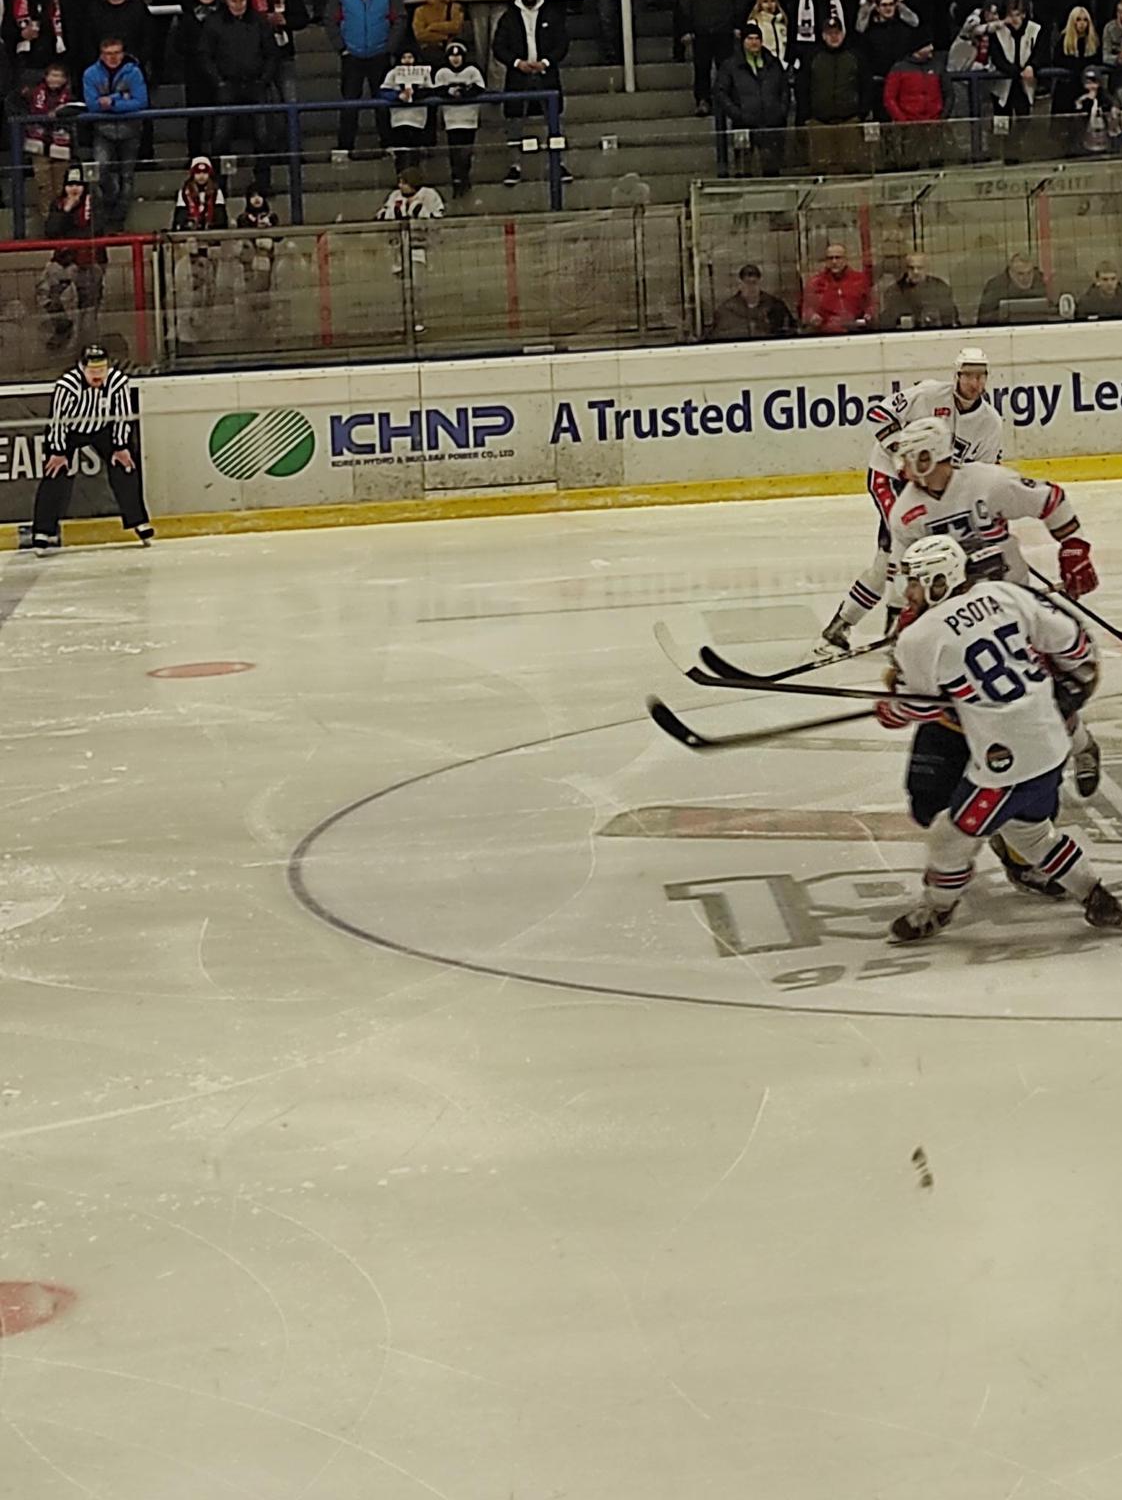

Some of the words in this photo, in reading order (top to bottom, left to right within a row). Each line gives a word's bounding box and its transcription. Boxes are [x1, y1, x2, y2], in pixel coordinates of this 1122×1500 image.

[329, 405, 515, 457] KHNP
[550, 402, 582, 444] A
[588, 389, 752, 441] Trusted
[763, 380, 900, 430] Glob
[363, 457, 394, 466] HYDRO
[406, 453, 446, 464] NUCLEAR
[448, 451, 479, 461] POWER
[499, 449, 514, 458] LTD
[944, 595, 1004, 636] PSOTA
[964, 621, 1048, 703] 85
[771, 952, 932, 992] 95
